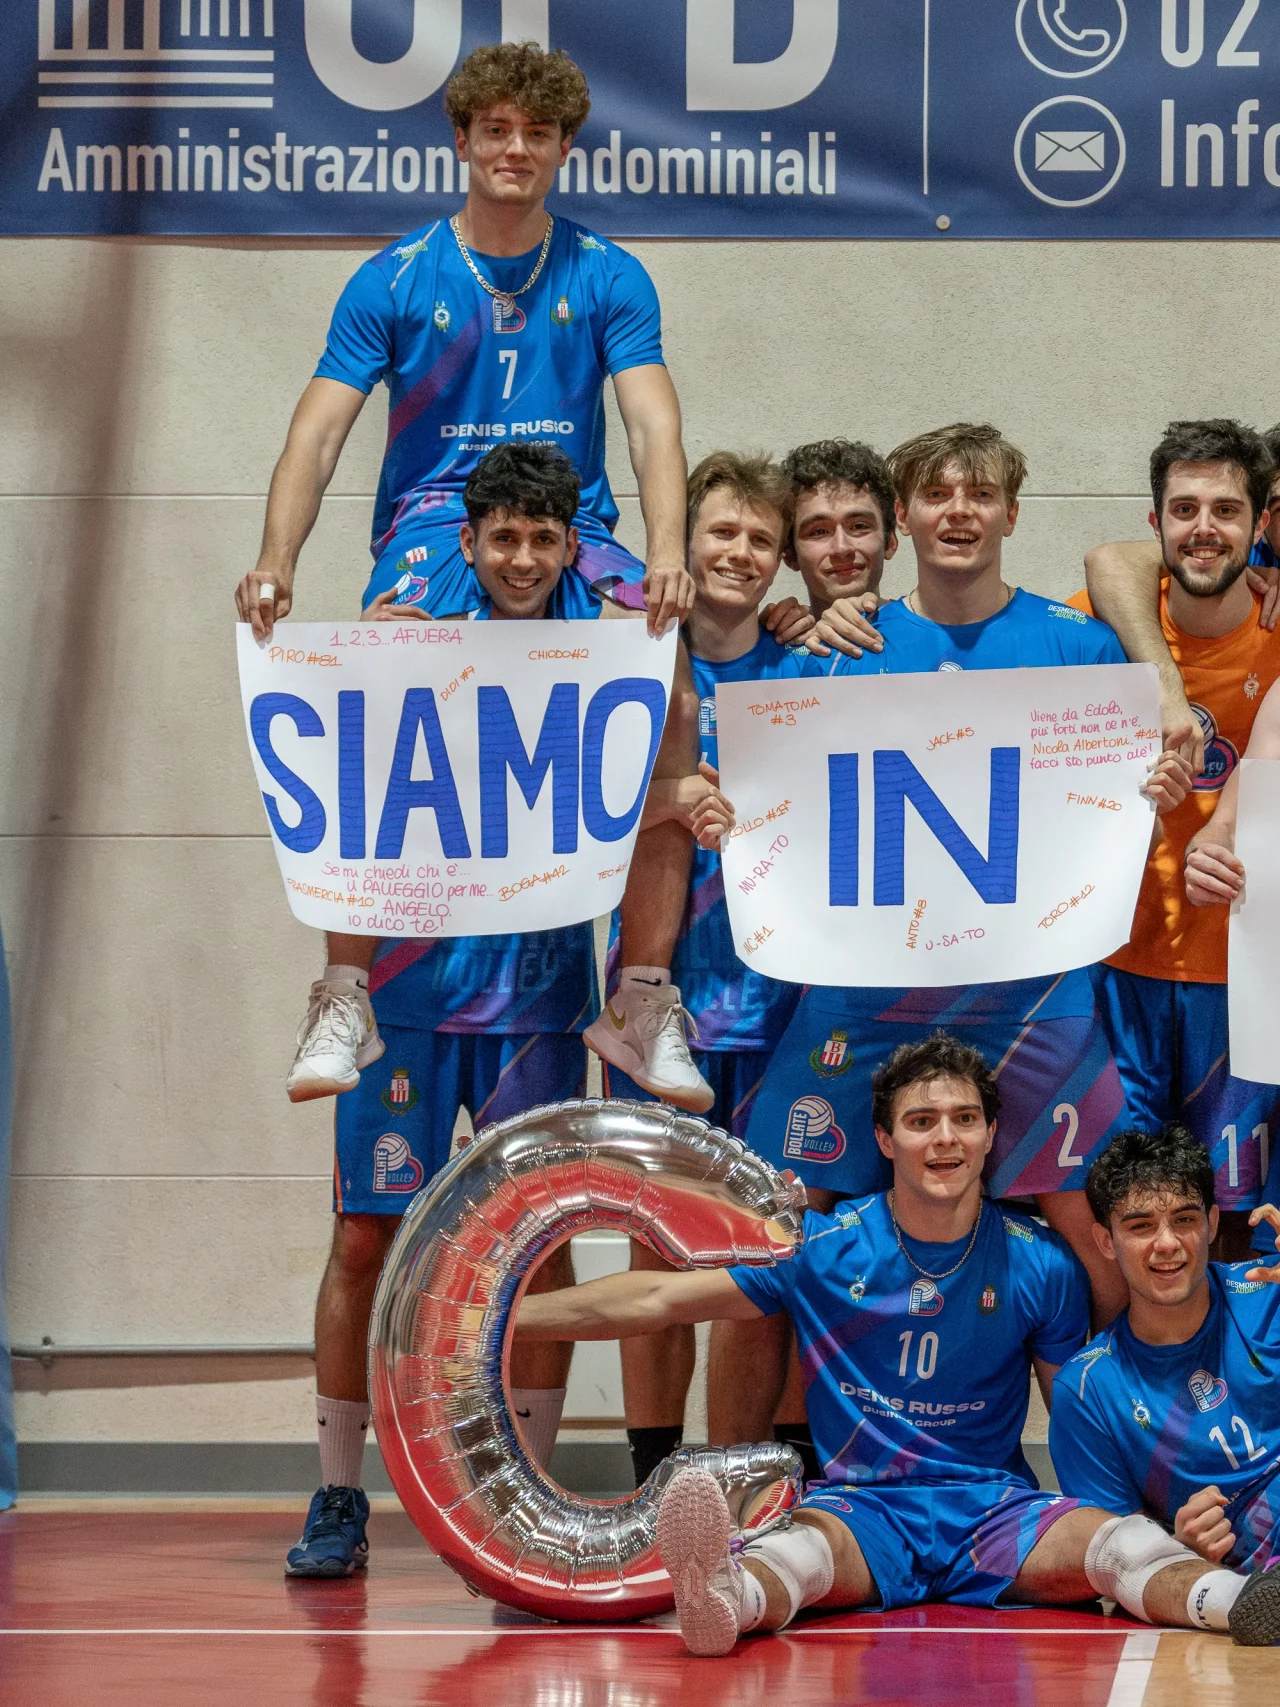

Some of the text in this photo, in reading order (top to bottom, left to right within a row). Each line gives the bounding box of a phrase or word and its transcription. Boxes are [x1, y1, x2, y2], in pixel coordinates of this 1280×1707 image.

[1160, 0, 1260, 68] 02
[558, 129, 837, 196] ndominiali
[499, 349, 518, 399] 7
[440, 423, 506, 438] DENIS
[458, 443, 496, 452] BUSIN
[392, 627, 463, 646] AFUERA
[701, 707, 709, 733] BOLLATE
[770, 714, 797, 726] #3
[1030, 709, 1057, 722] Viene
[1062, 708, 1079, 721] da
[1053, 723, 1076, 736] forti
[1081, 724, 1100, 733] non
[1033, 740, 1069, 755] Nicola
[249, 677, 666, 859] SIAMO
[1086, 753, 1121, 768] punto
[828, 746, 1021, 907] IN
[321, 861, 340, 876] Se
[364, 864, 409, 880] chiedi
[416, 864, 440, 879] chi
[447, 885, 466, 901] per
[367, 914, 405, 931] dico
[831, 1041, 841, 1053] B
[395, 1079, 405, 1090] B
[787, 1112, 807, 1155] BOLLATE
[1053, 1103, 1083, 1168] 2
[803, 1138, 835, 1152] VOLLEY
[1221, 1122, 1269, 1187] 11
[376, 1150, 388, 1189] BOLLATE
[911, 1288, 922, 1314] BOLLATE
[898, 1330, 939, 1380] 10
[1190, 1382, 1210, 1411] BOLLATE
[908, 1400, 986, 1415] RUSSO
[915, 1418, 956, 1428] GROUP
[1209, 1415, 1267, 1470] 12
